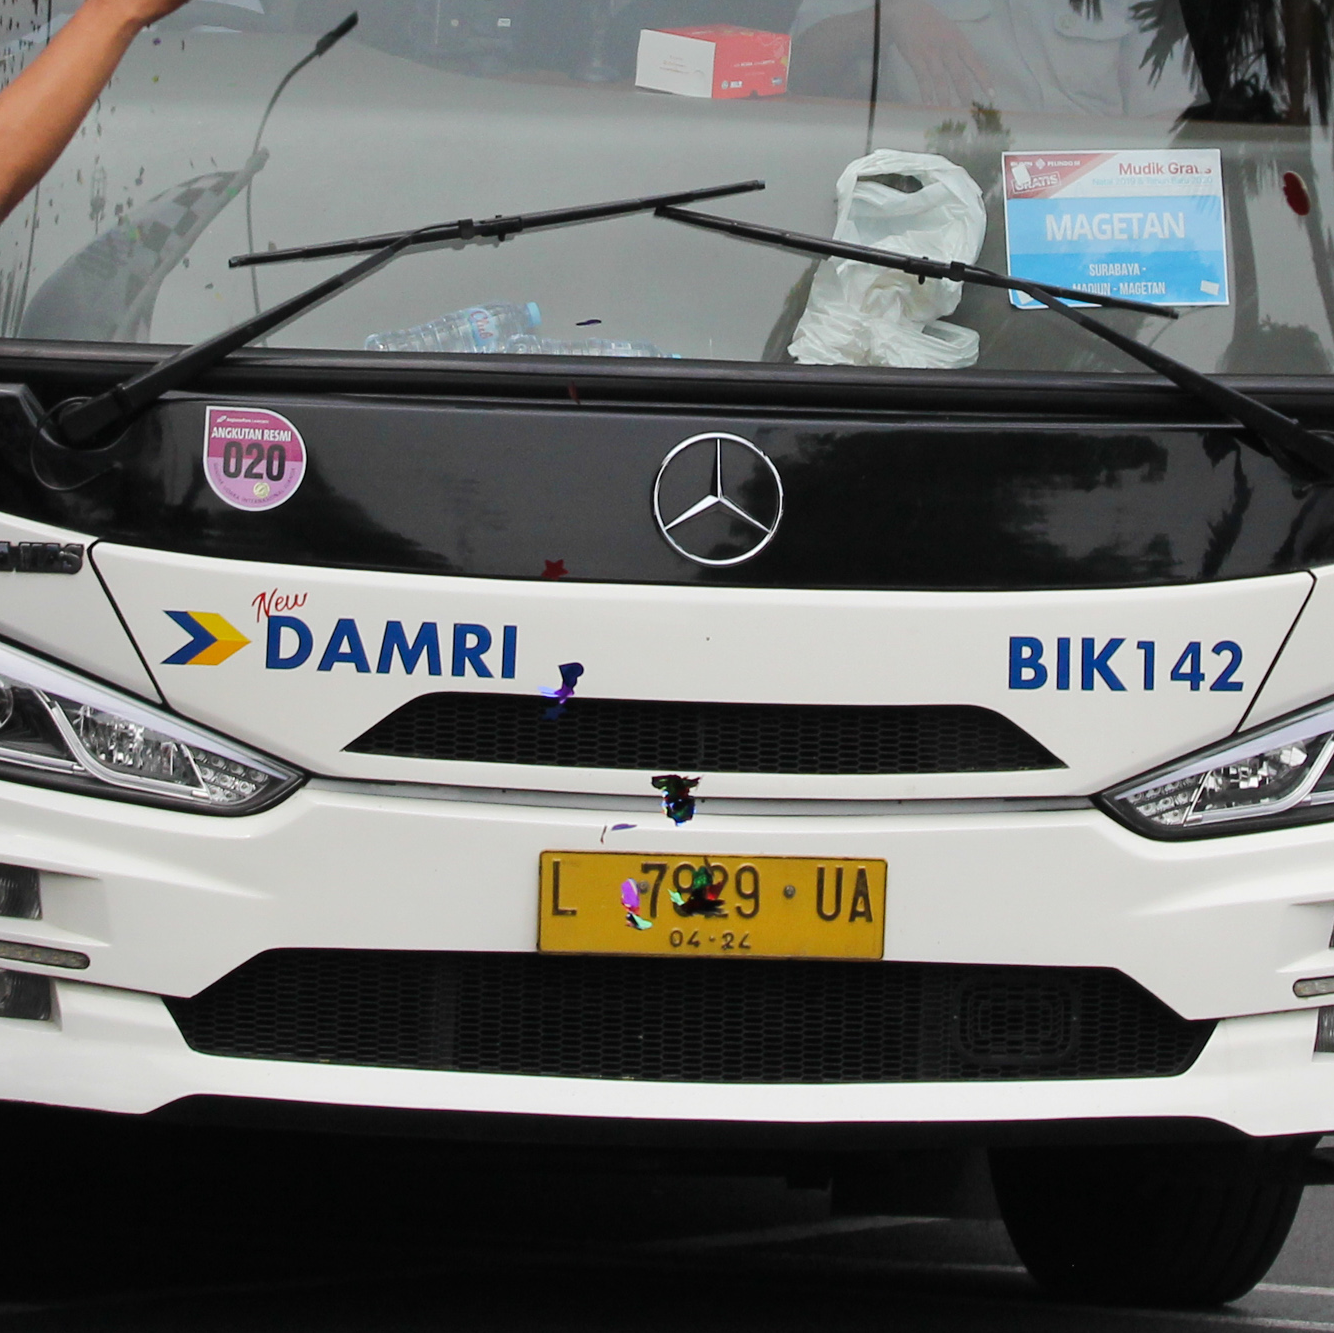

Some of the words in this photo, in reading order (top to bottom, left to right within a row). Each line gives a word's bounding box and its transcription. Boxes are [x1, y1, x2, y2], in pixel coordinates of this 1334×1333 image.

[1119, 162, 1164, 175] Mudik
[1168, 162, 1212, 175] Grats
[1046, 213, 1185, 241] MAGETAN
[1089, 263, 1141, 277] SURABAYA
[1119, 282, 1166, 295] MAGETAN
[211, 427, 262, 440] ANGKUTAN
[264, 430, 292, 441] RESMI
[223, 441, 286, 482] 020
[252, 588, 308, 623] New
[266, 615, 518, 680] DAMRI
[1008, 636, 1244, 692] BIK142
[551, 859, 577, 916] L
[817, 866, 874, 923] UA
